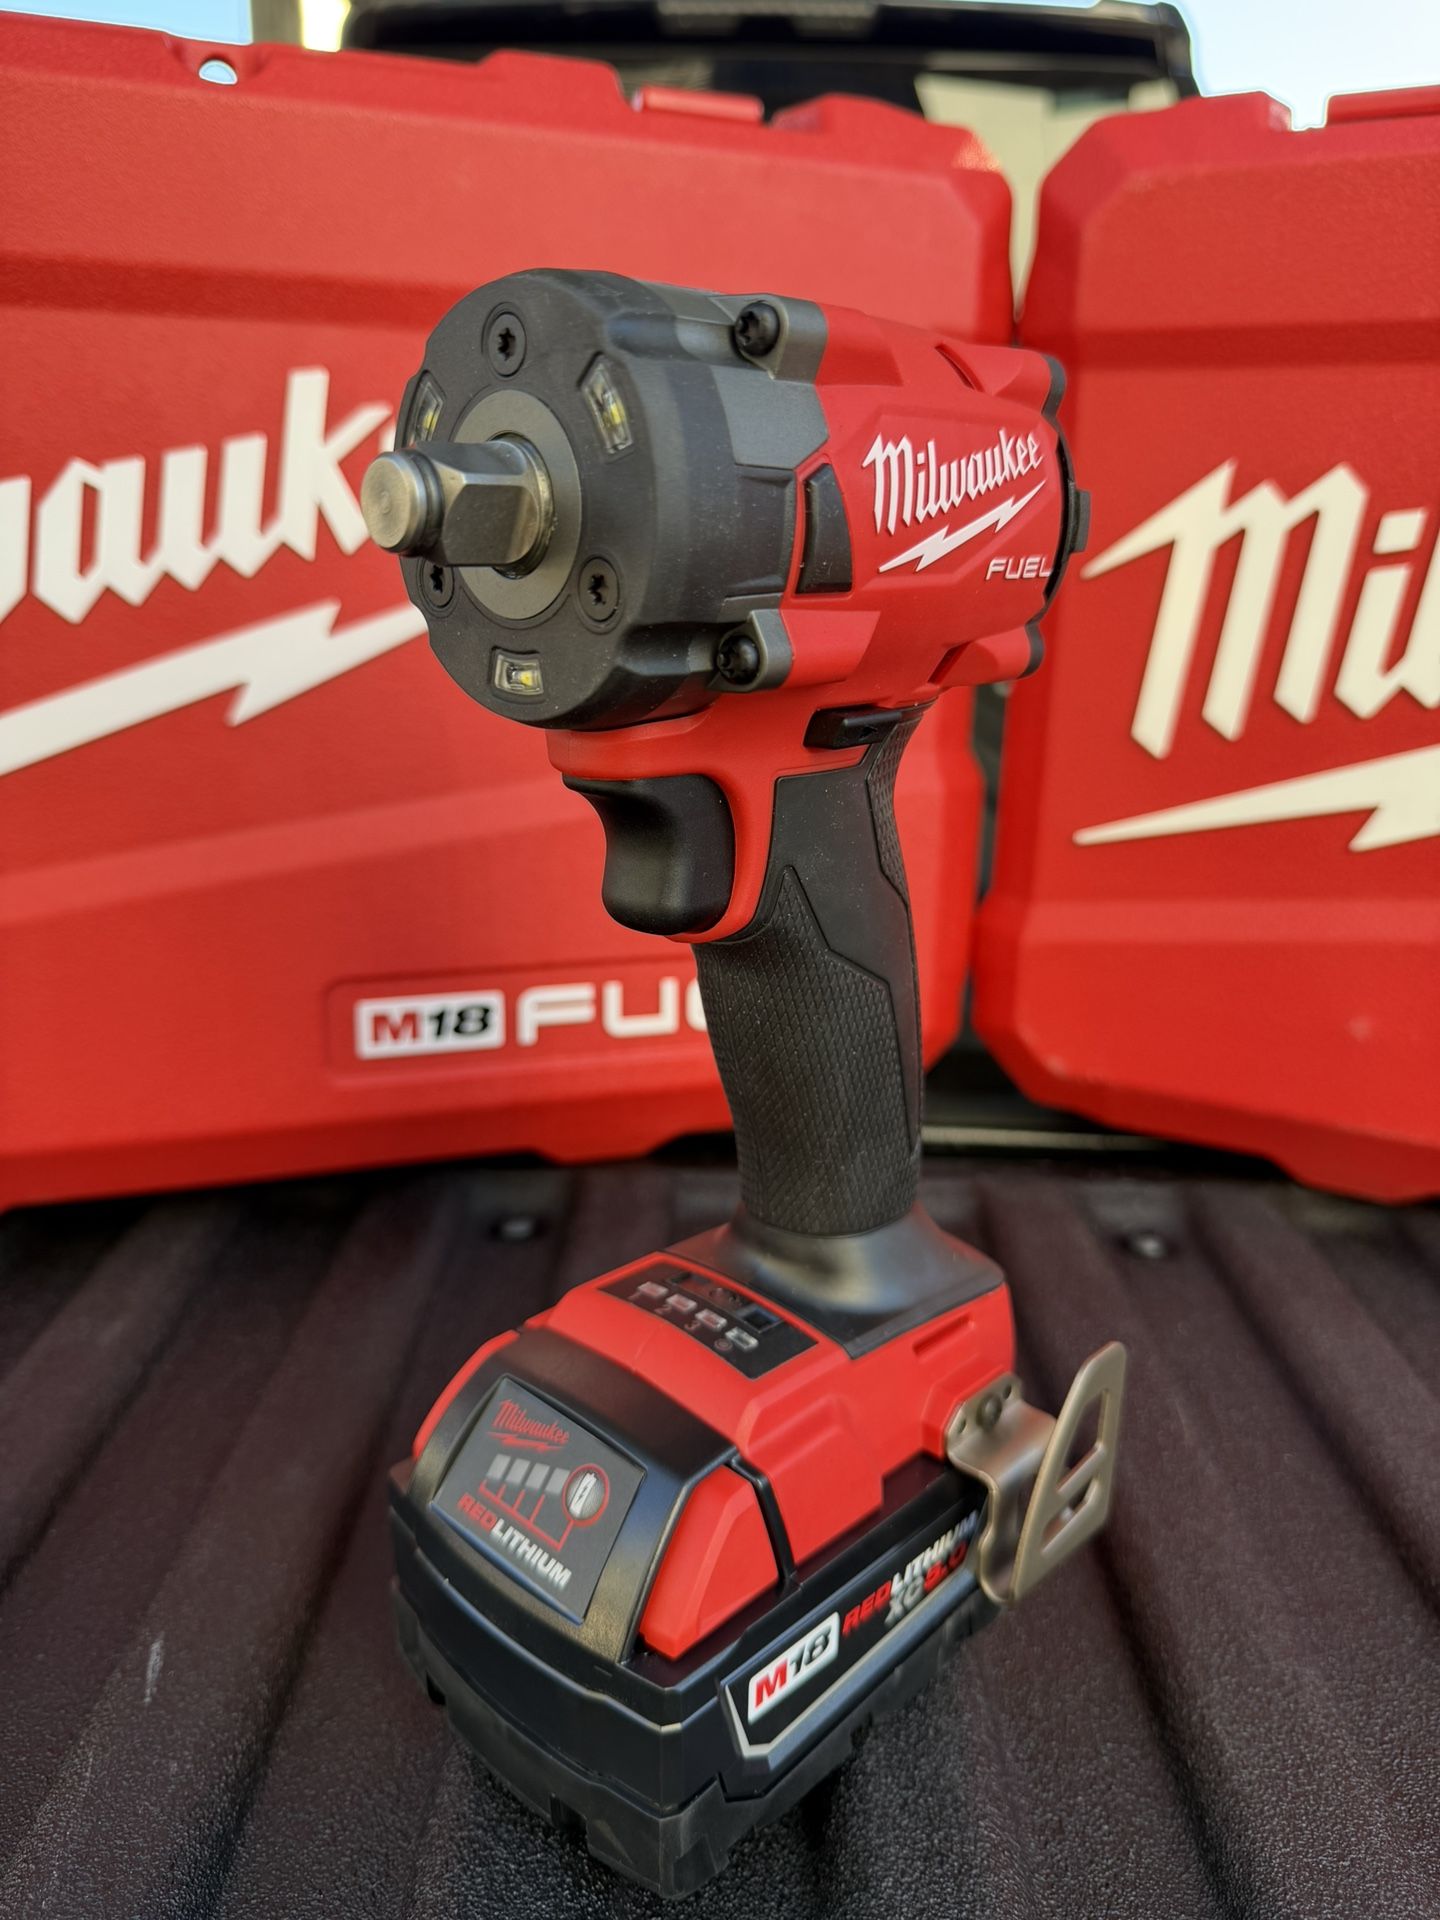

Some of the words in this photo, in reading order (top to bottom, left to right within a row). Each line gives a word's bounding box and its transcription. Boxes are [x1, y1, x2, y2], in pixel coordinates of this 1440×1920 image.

[0, 364, 401, 625] auk
[861, 427, 1044, 536] Milwaukee
[985, 556, 1052, 581] FUEL
[370, 1004, 494, 1047] M18
[516, 975, 709, 1048] FU
[654, 1303, 673, 1315] 2
[684, 1319, 702, 1331] 3
[491, 1399, 570, 1445] Milwaukee
[456, 1492, 573, 1589] REDLITHIUM
[754, 1625, 833, 1709] M18
